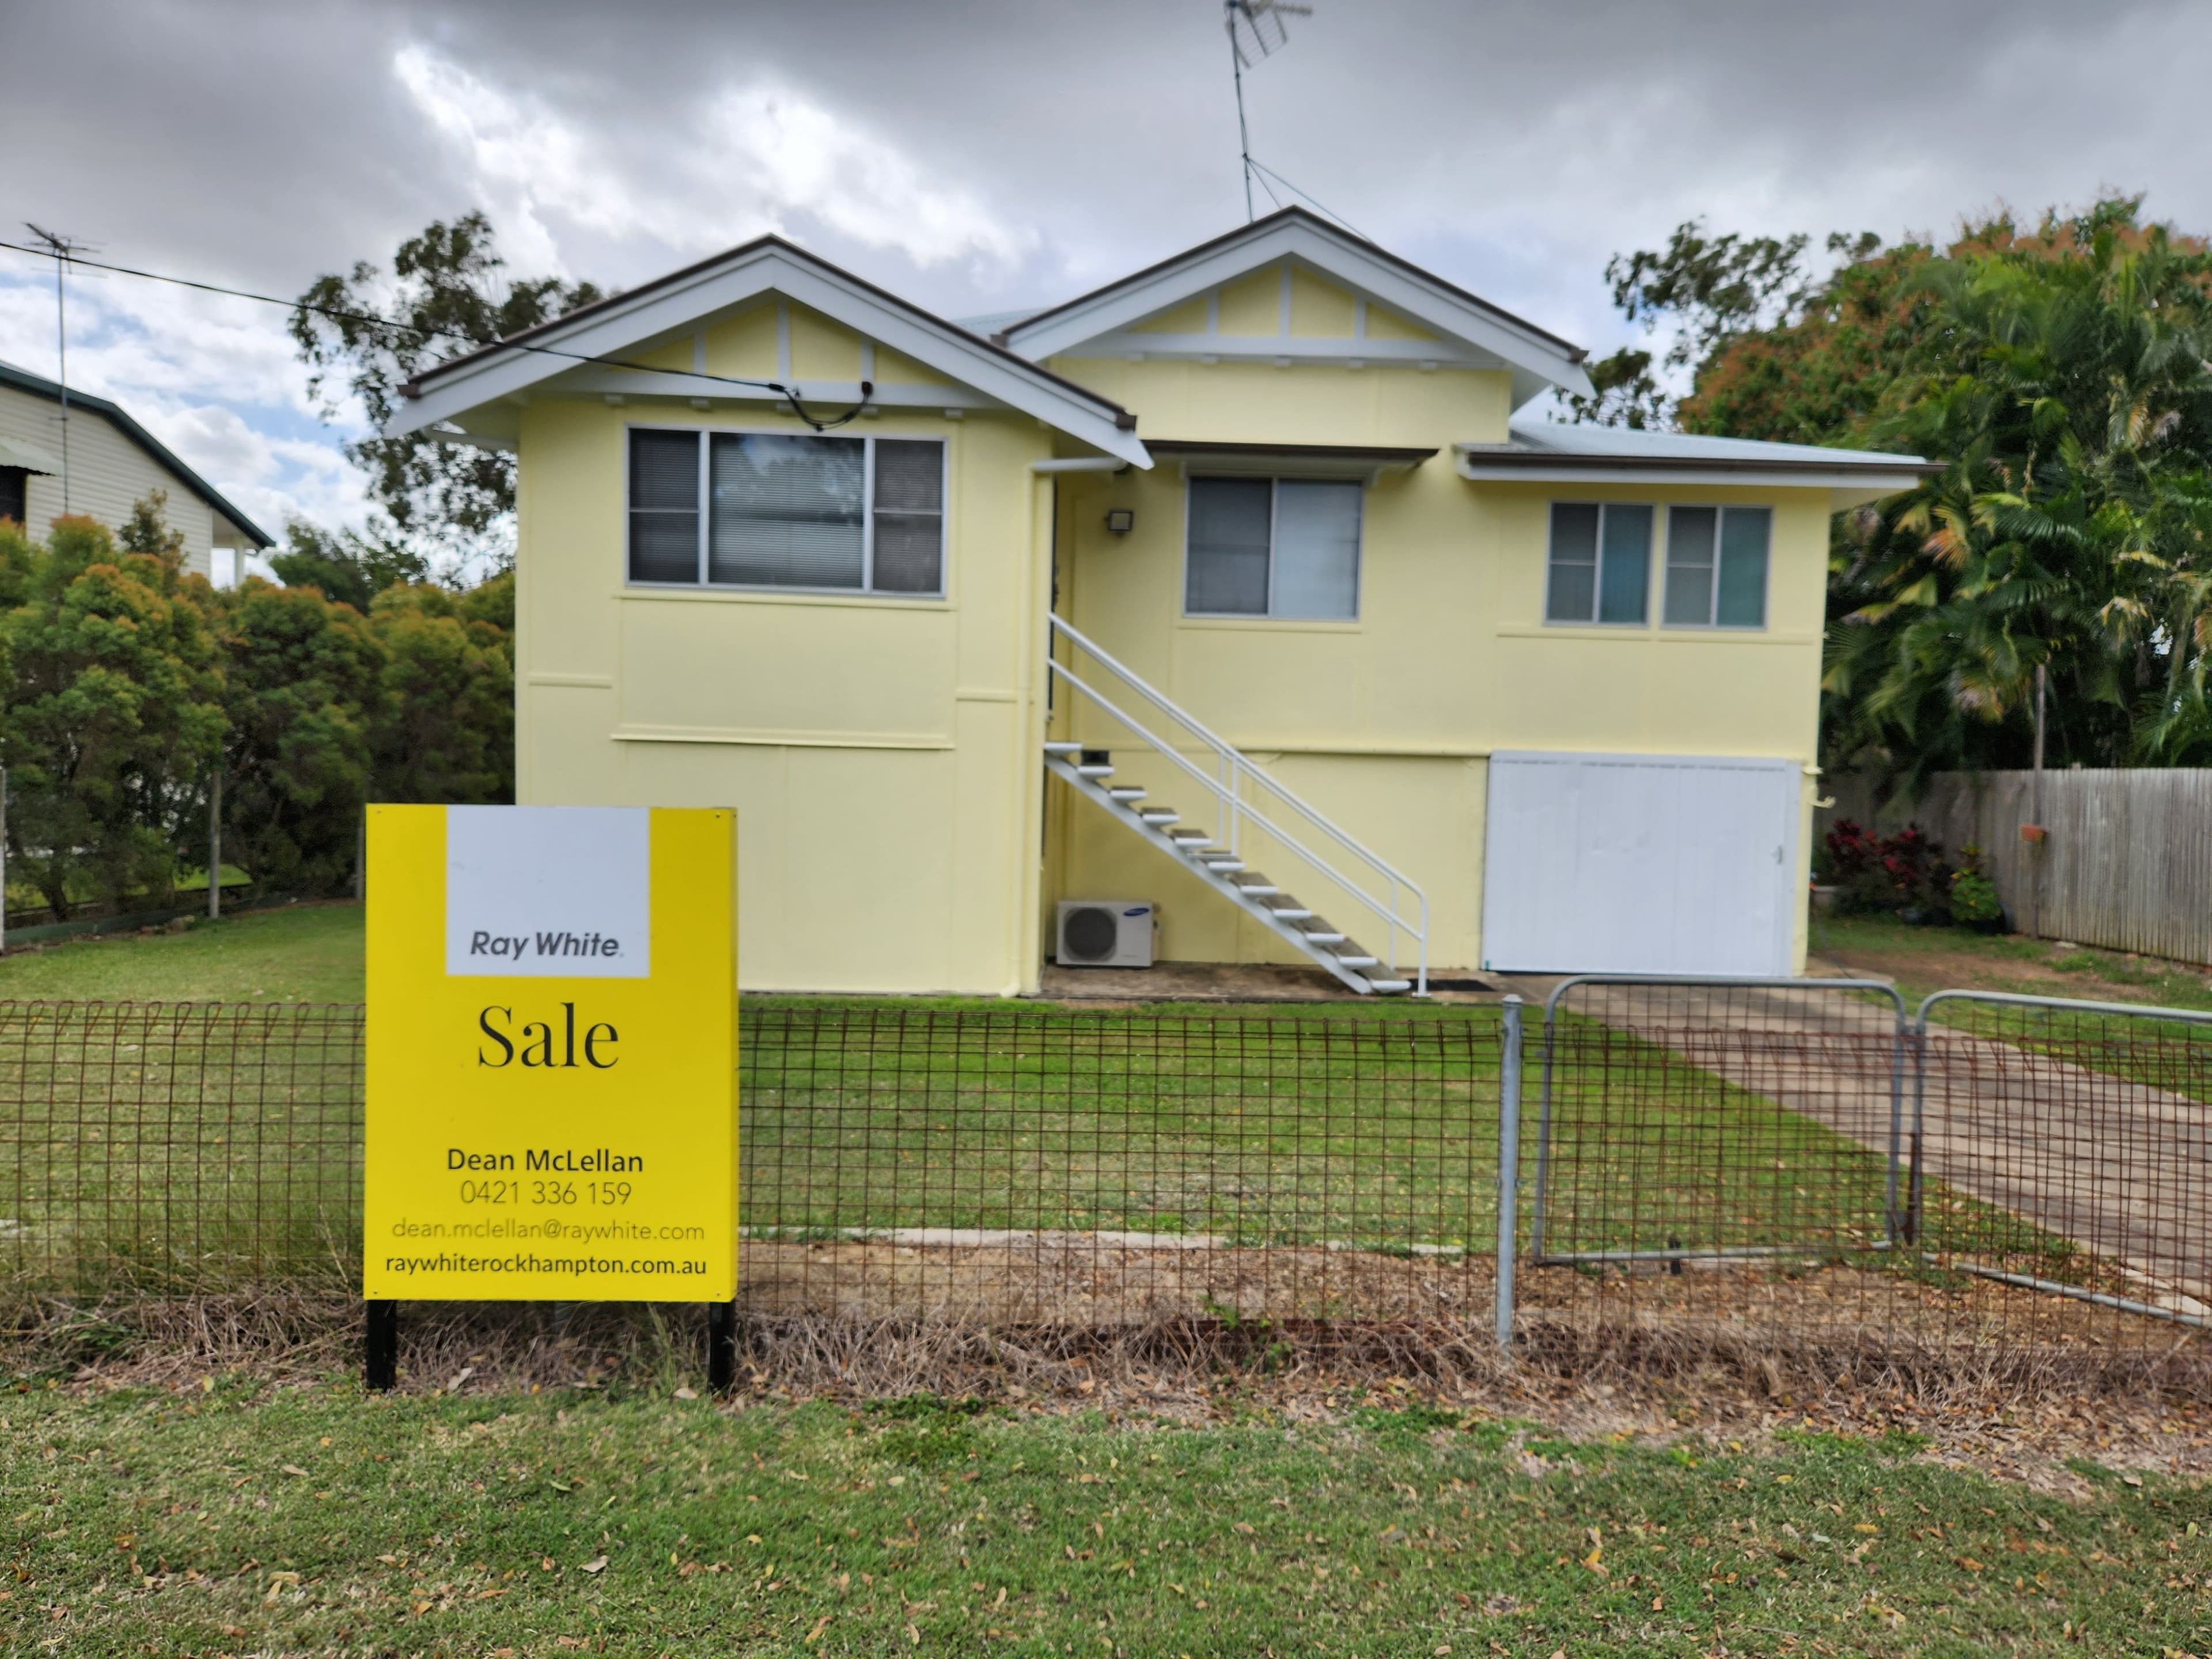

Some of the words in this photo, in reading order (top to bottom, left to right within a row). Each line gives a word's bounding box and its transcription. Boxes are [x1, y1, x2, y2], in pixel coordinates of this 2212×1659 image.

[470, 931, 529, 961] Ray
[479, 1002, 619, 1069] Sale
[447, 1149, 515, 1171] Dean
[526, 1149, 643, 1173] McLellan
[460, 1180, 519, 1204] 0421
[532, 1181, 577, 1205] 336
[588, 1182, 632, 1205] 159
[392, 1218, 704, 1244] dean.mclellan@raywhite.com
[386, 1254, 706, 1277] raywhiterockhampton.com.au
